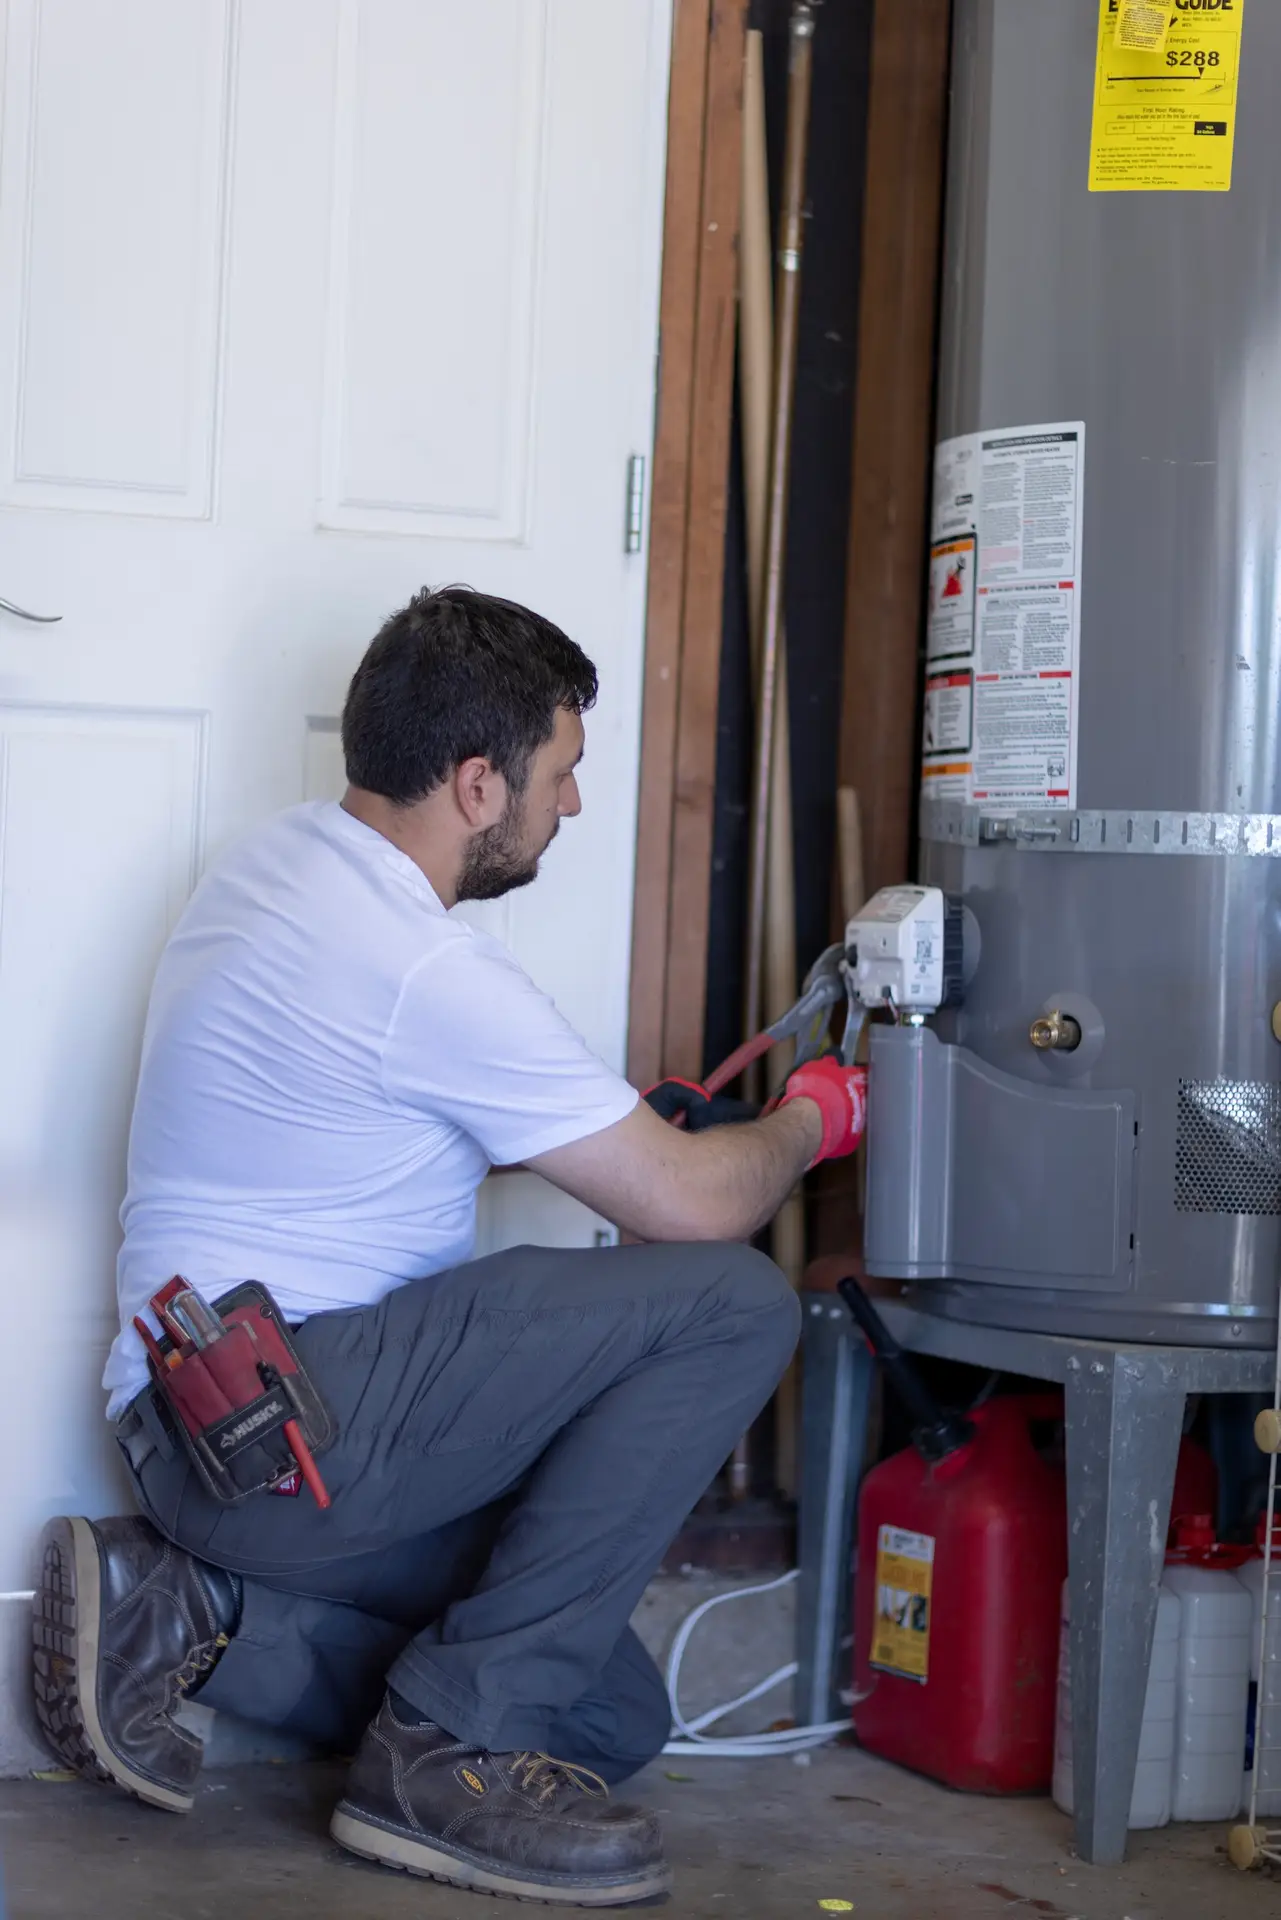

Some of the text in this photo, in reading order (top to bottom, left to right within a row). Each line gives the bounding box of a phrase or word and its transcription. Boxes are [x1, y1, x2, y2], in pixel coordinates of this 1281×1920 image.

[1175, 0, 1233, 10] GUIDE
[1165, 50, 1220, 67] $288
[232, 1400, 284, 1440] HUSKY
[462, 1769, 484, 1793] KEEN
